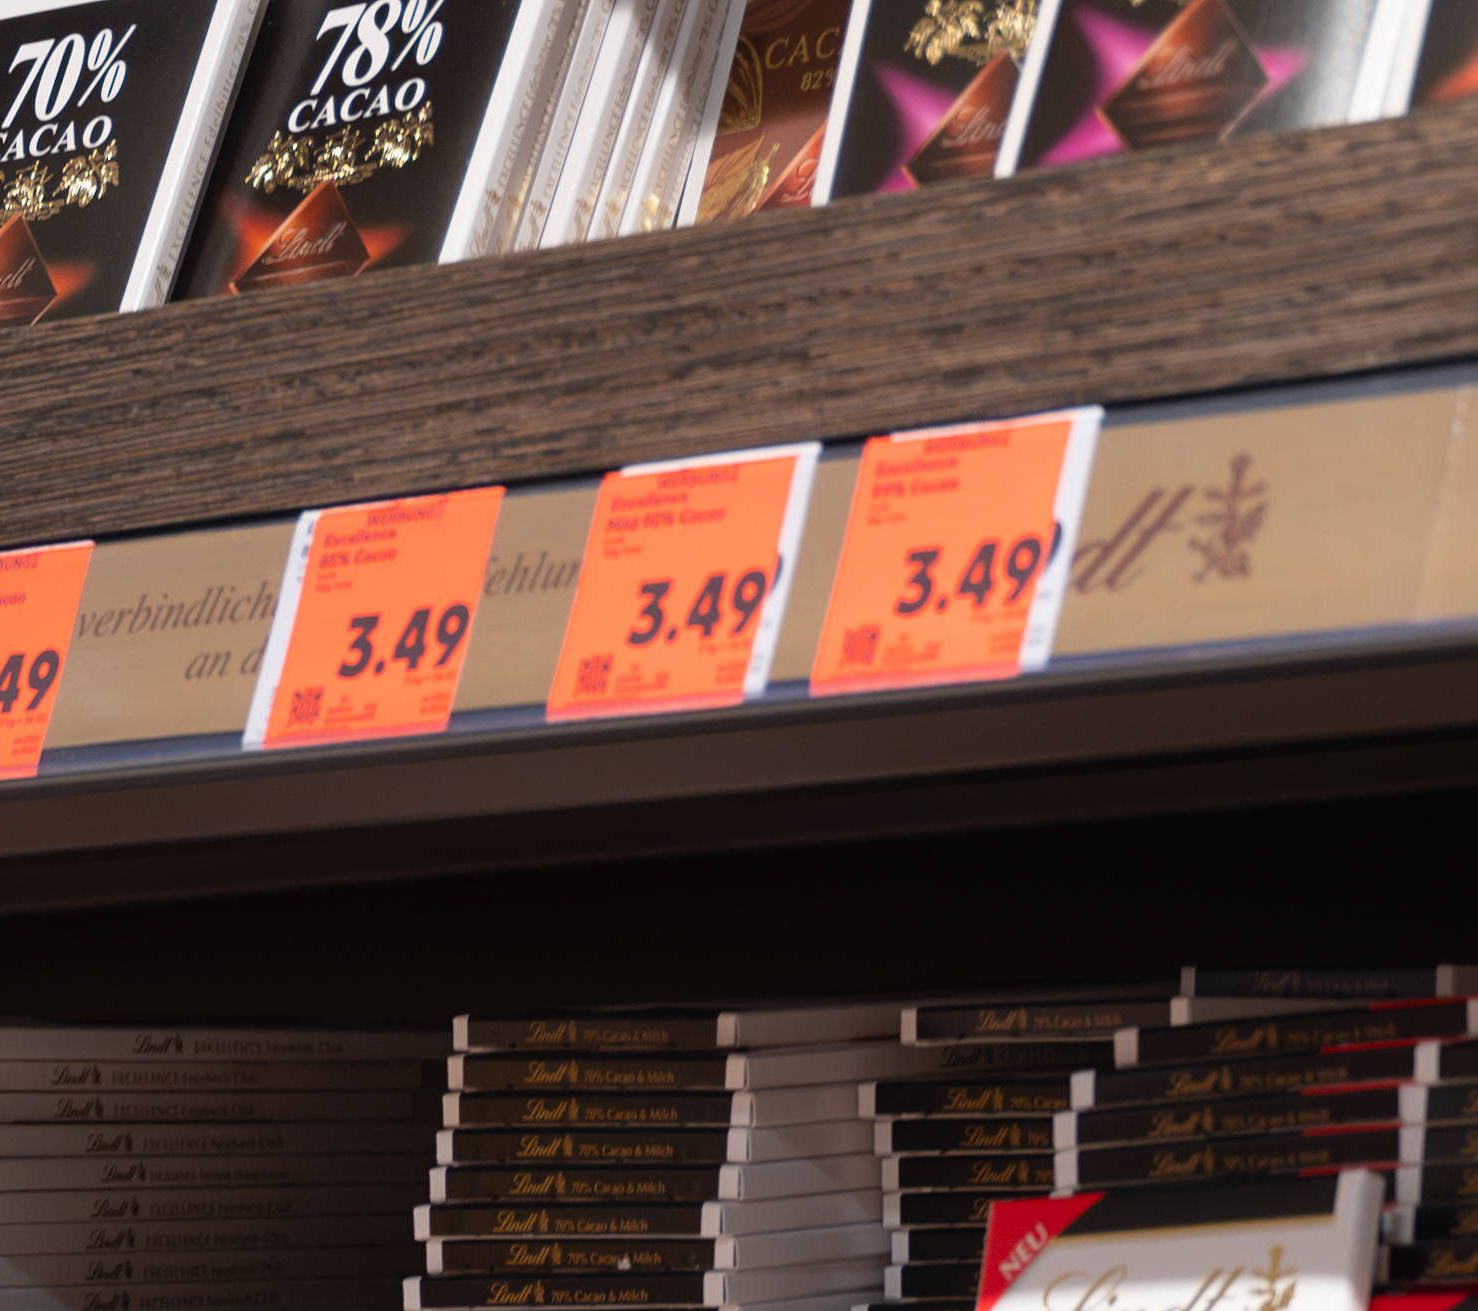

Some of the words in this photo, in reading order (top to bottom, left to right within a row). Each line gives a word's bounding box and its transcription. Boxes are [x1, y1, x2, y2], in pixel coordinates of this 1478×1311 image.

[1, 25, 138, 130] 70%
[289, 78, 426, 135] CACAO
[996, 1223, 1049, 1281] NEU
